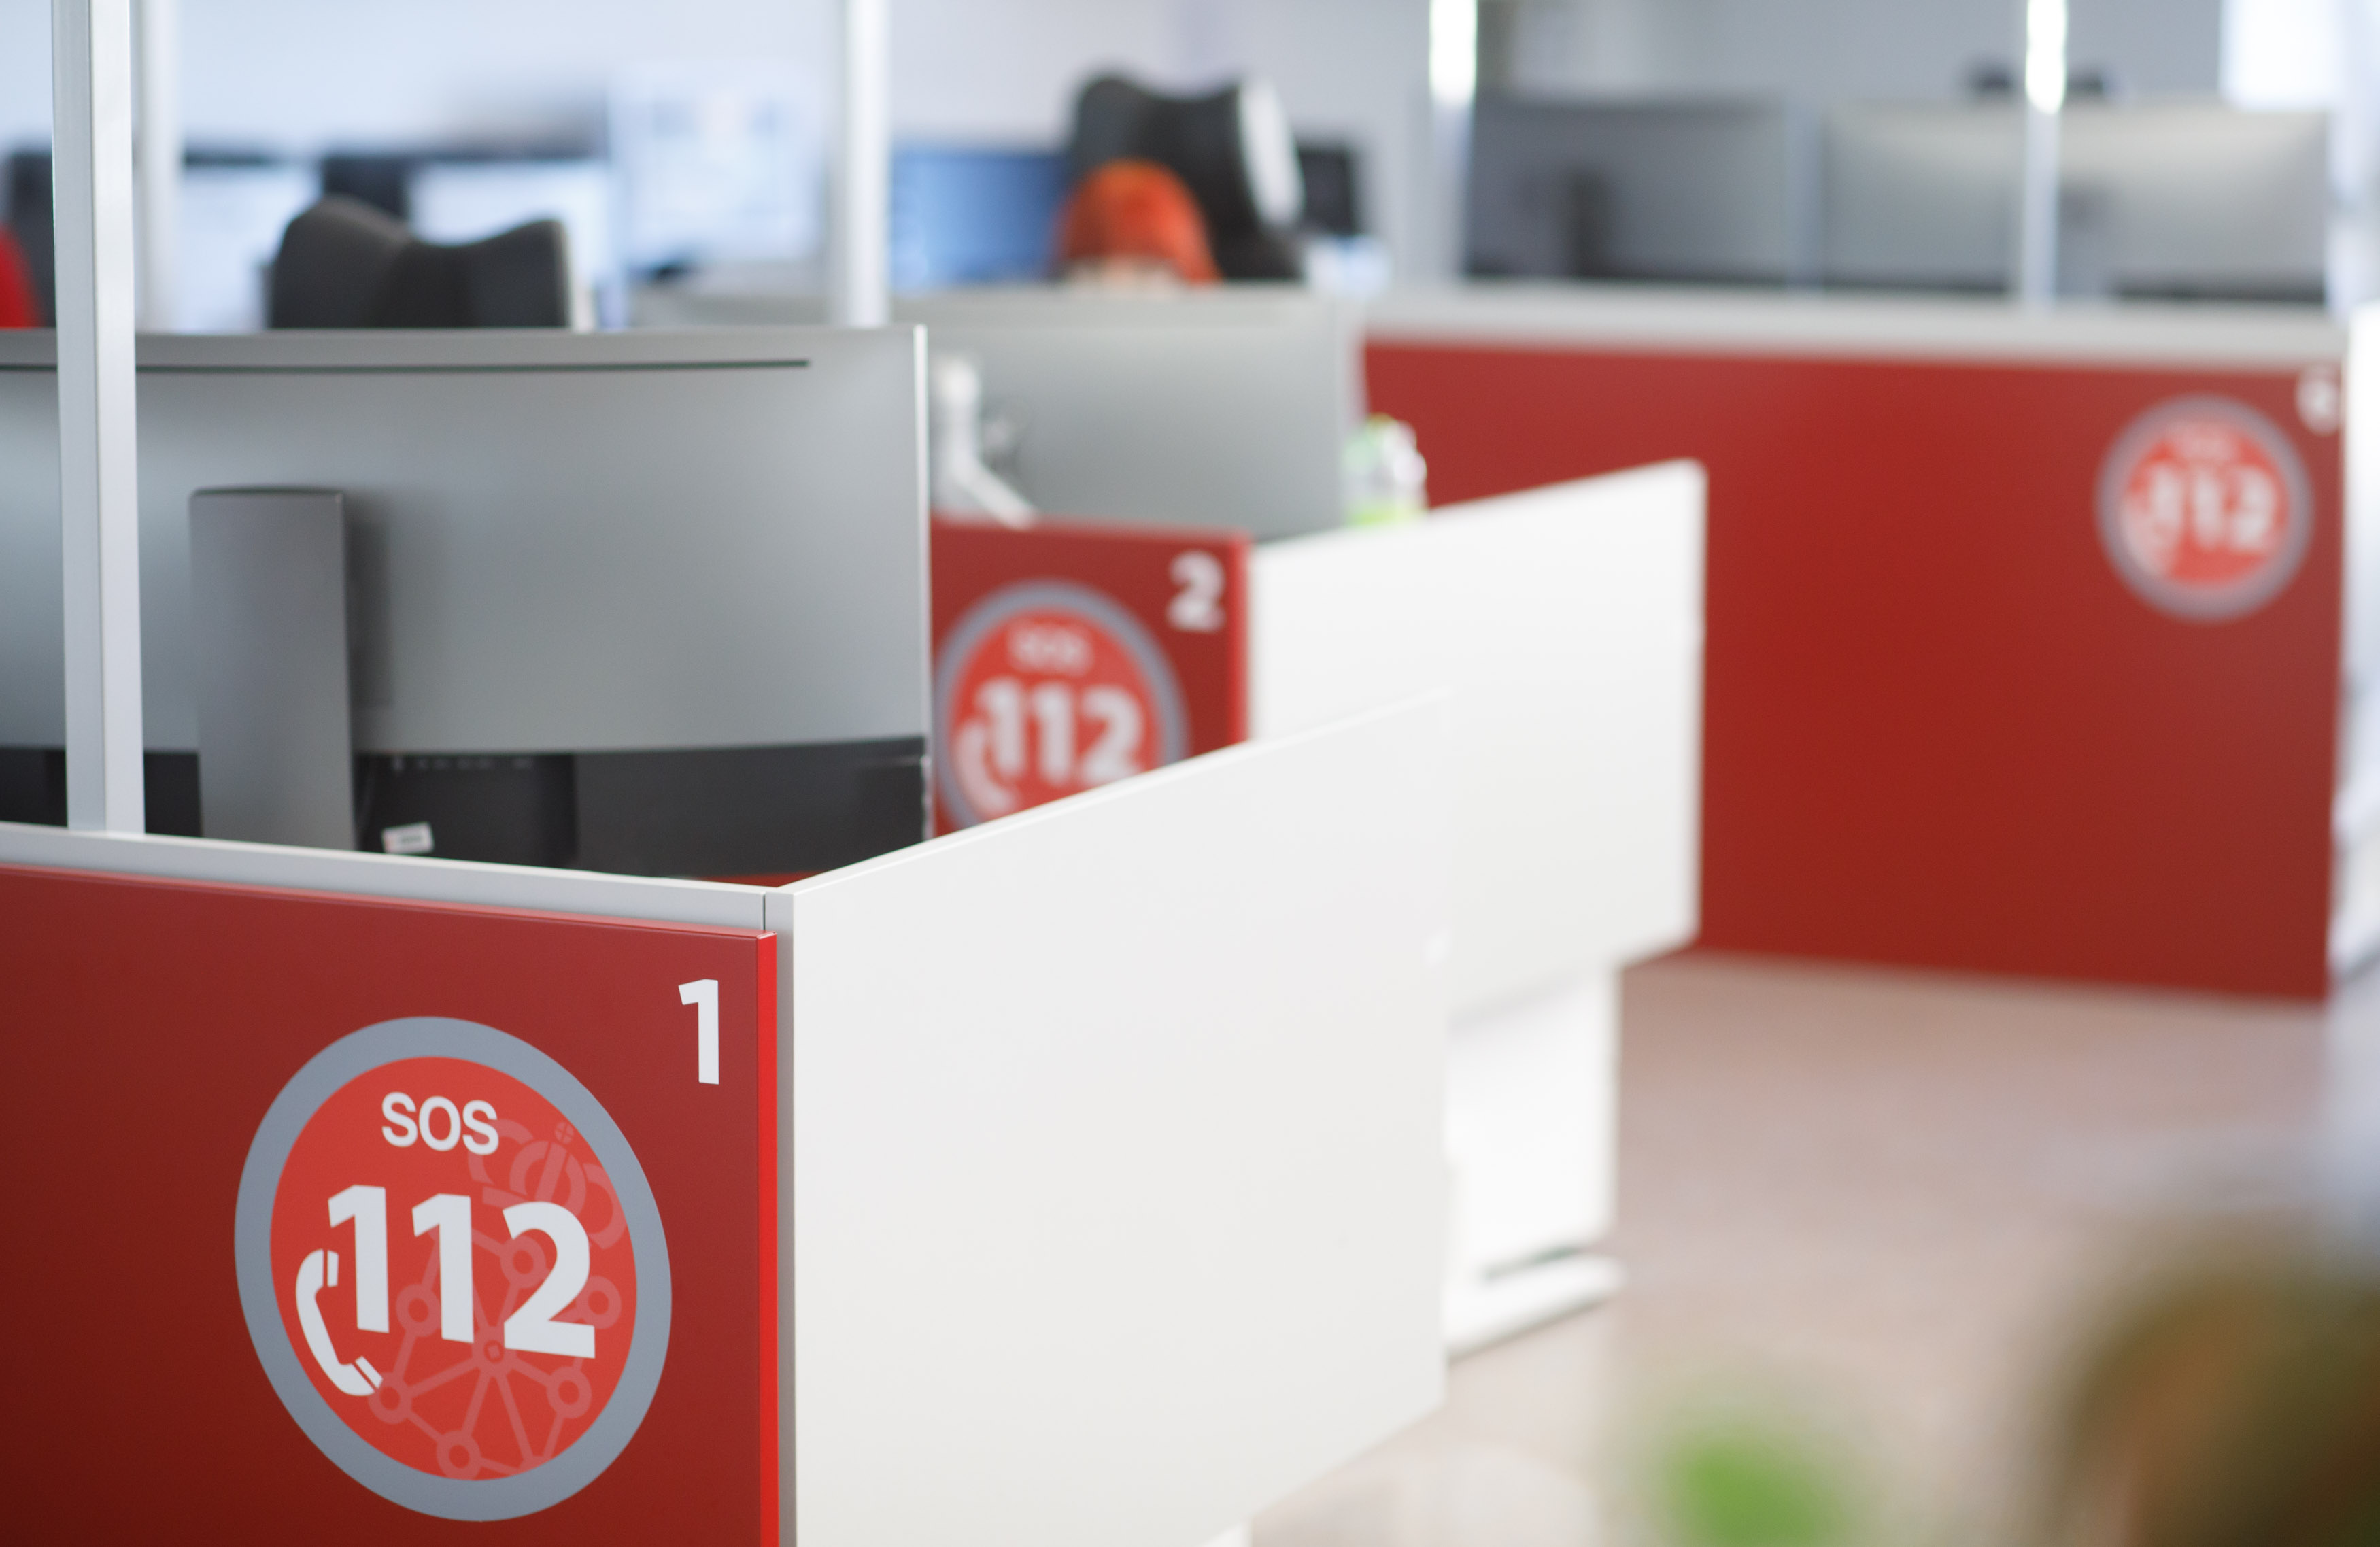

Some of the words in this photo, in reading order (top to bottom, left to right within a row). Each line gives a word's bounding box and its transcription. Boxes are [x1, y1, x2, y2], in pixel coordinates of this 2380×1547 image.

[1166, 551, 1225, 632] 2
[976, 679, 1141, 786] 112
[678, 979, 719, 1085] 1
[381, 1091, 499, 1155] SOS
[327, 1184, 596, 1359] 112
